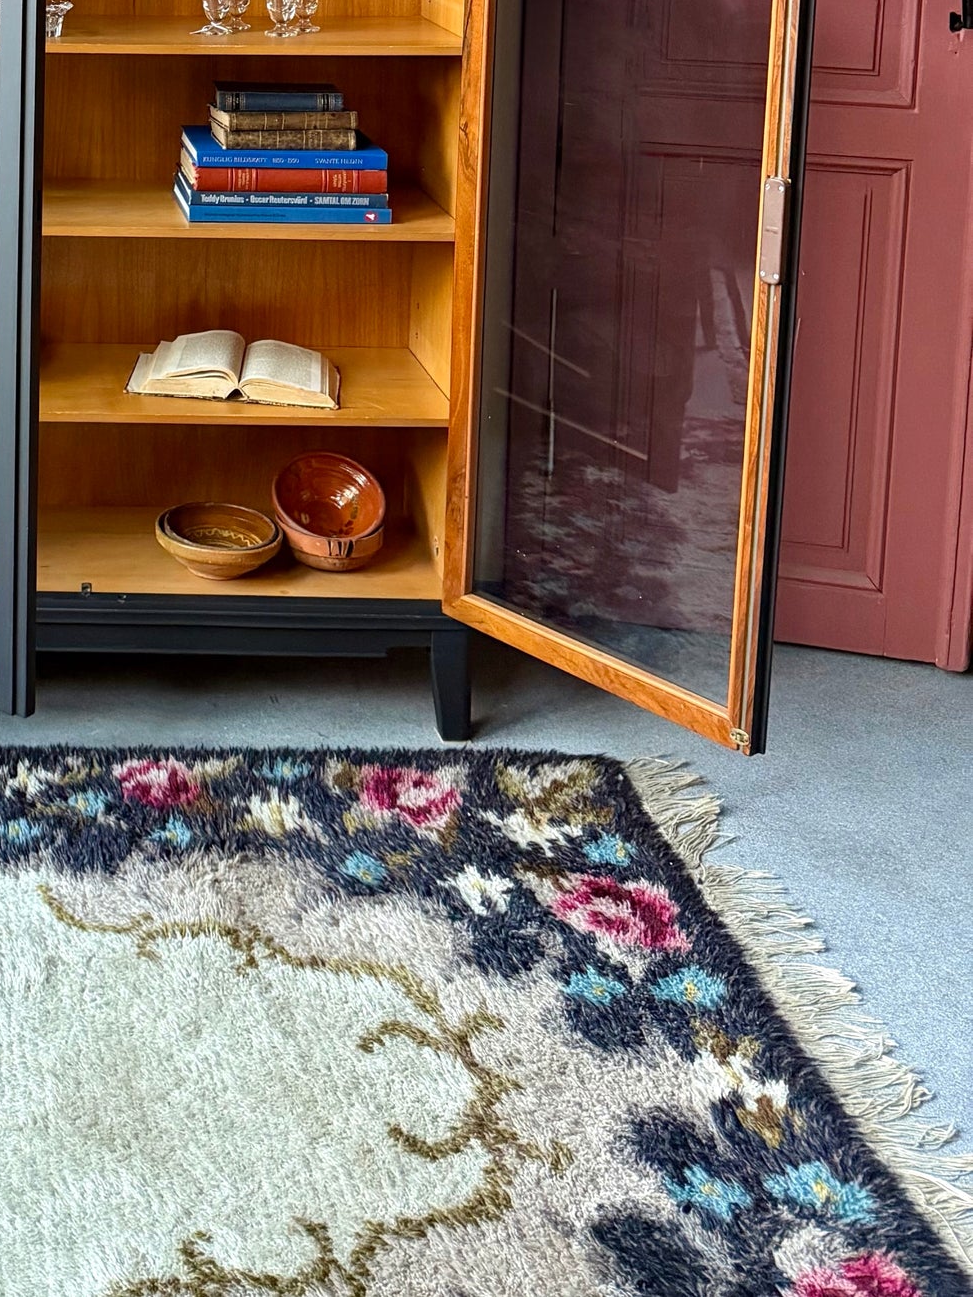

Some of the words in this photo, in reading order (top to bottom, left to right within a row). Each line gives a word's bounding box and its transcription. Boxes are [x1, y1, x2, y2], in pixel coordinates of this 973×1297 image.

[314, 157, 340, 165] SVANTE
[201, 193, 220, 204] Teddy
[250, 194, 269, 204] Oscar
[314, 196, 340, 205] SAMTAL
[340, 197, 352, 205] OM
[352, 197, 370, 206] ZORN
